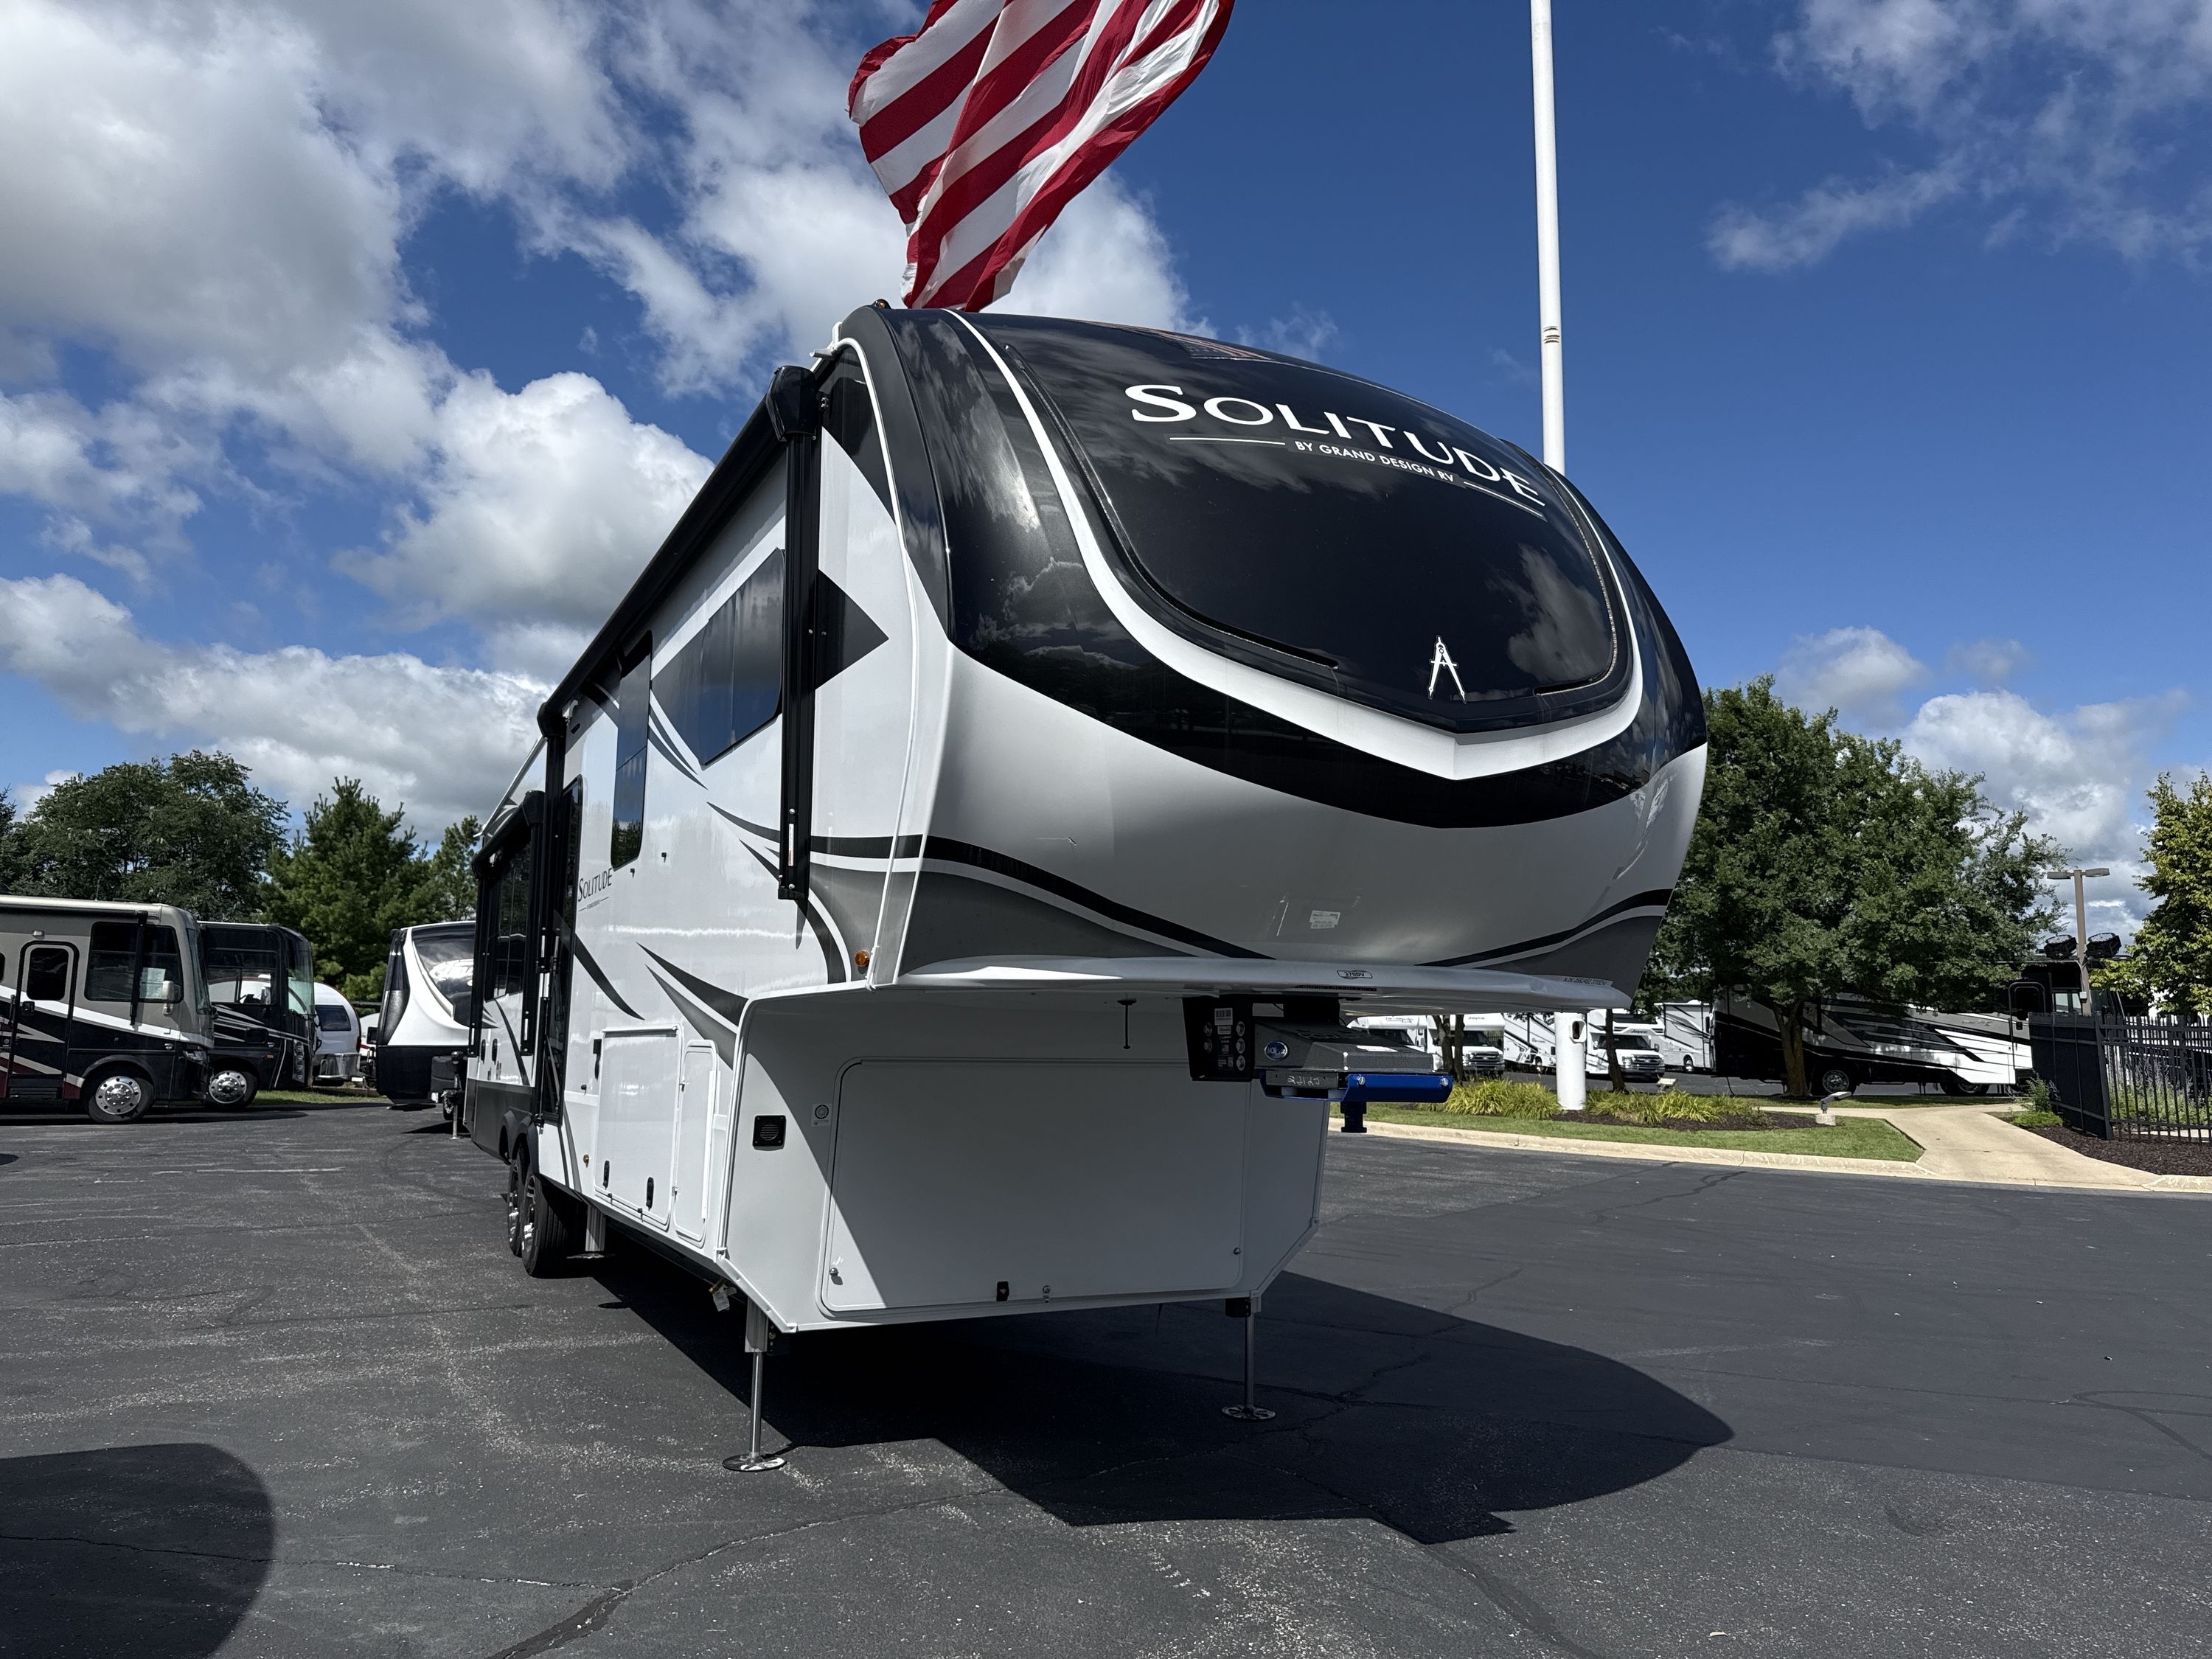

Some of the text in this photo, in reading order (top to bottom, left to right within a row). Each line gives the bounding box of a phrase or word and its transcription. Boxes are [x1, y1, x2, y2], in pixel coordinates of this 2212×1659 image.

[1124, 384, 1545, 506] SOLITUDE
[1295, 441, 1453, 482] BY GRAND DESIGN RV
[578, 868, 612, 902] SOLITUDE
